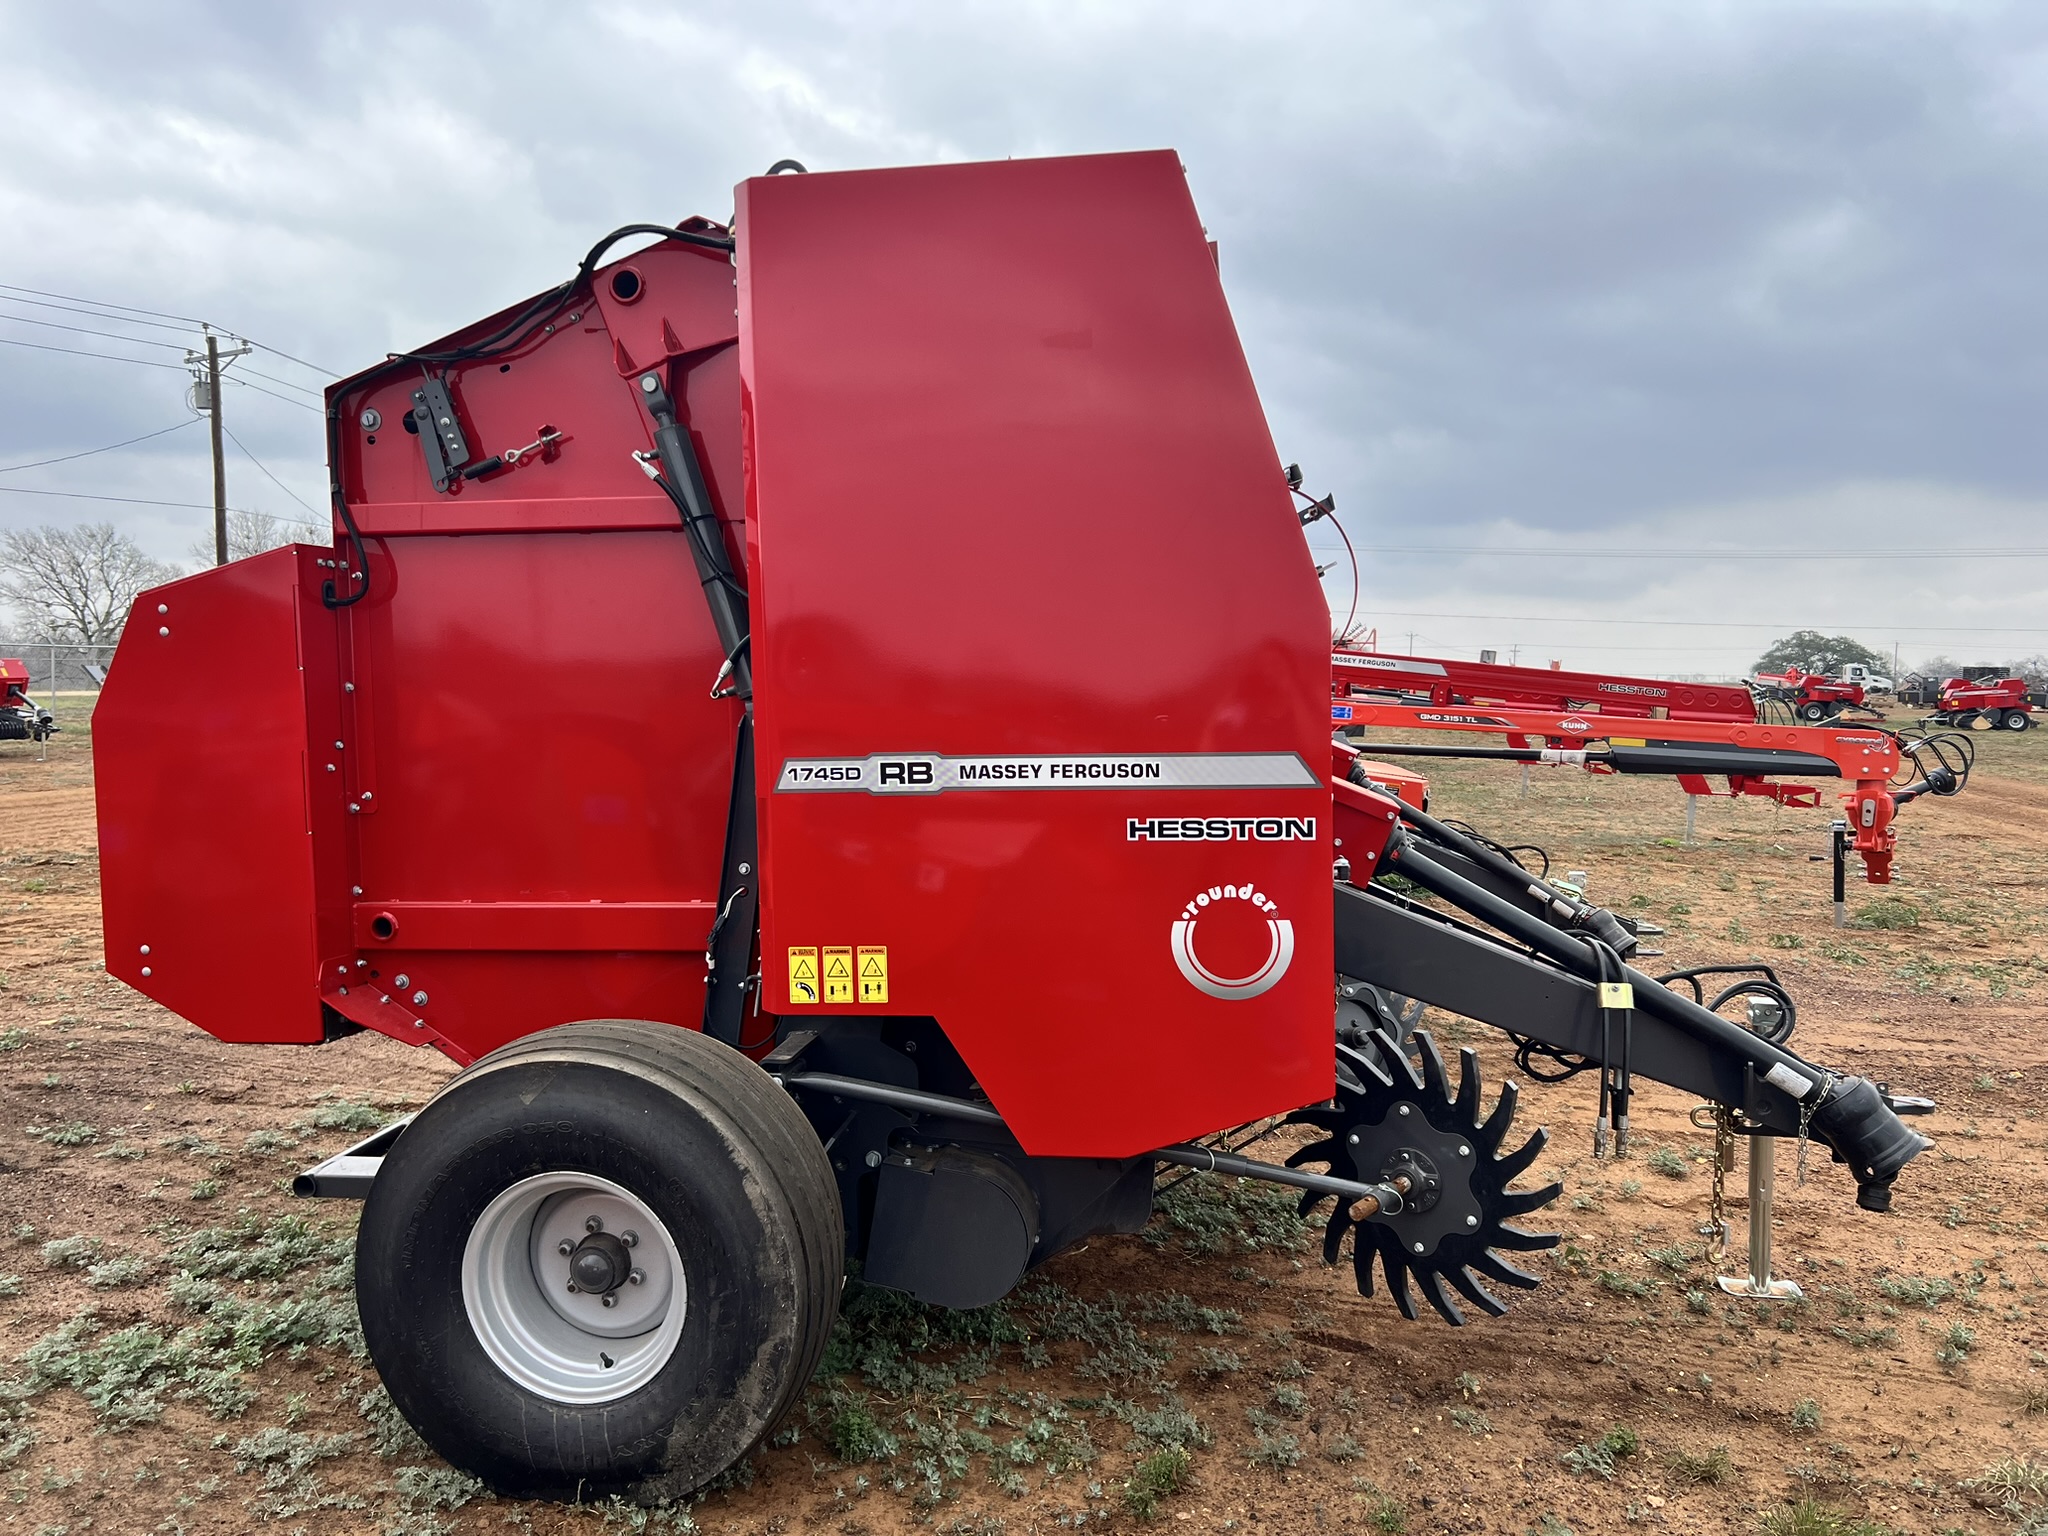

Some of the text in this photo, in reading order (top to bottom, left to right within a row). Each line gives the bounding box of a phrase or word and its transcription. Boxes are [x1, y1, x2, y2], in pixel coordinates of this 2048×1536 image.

[1358, 658, 1396, 668] FERGUSON
[1598, 683, 1666, 697] HESSTON
[1420, 713, 1441, 721] GMD
[1562, 722, 1587, 730] KUHN
[787, 761, 1160, 785] 1745D RB MASSEY FERGUSON
[1127, 818, 1316, 840] HESSTON
